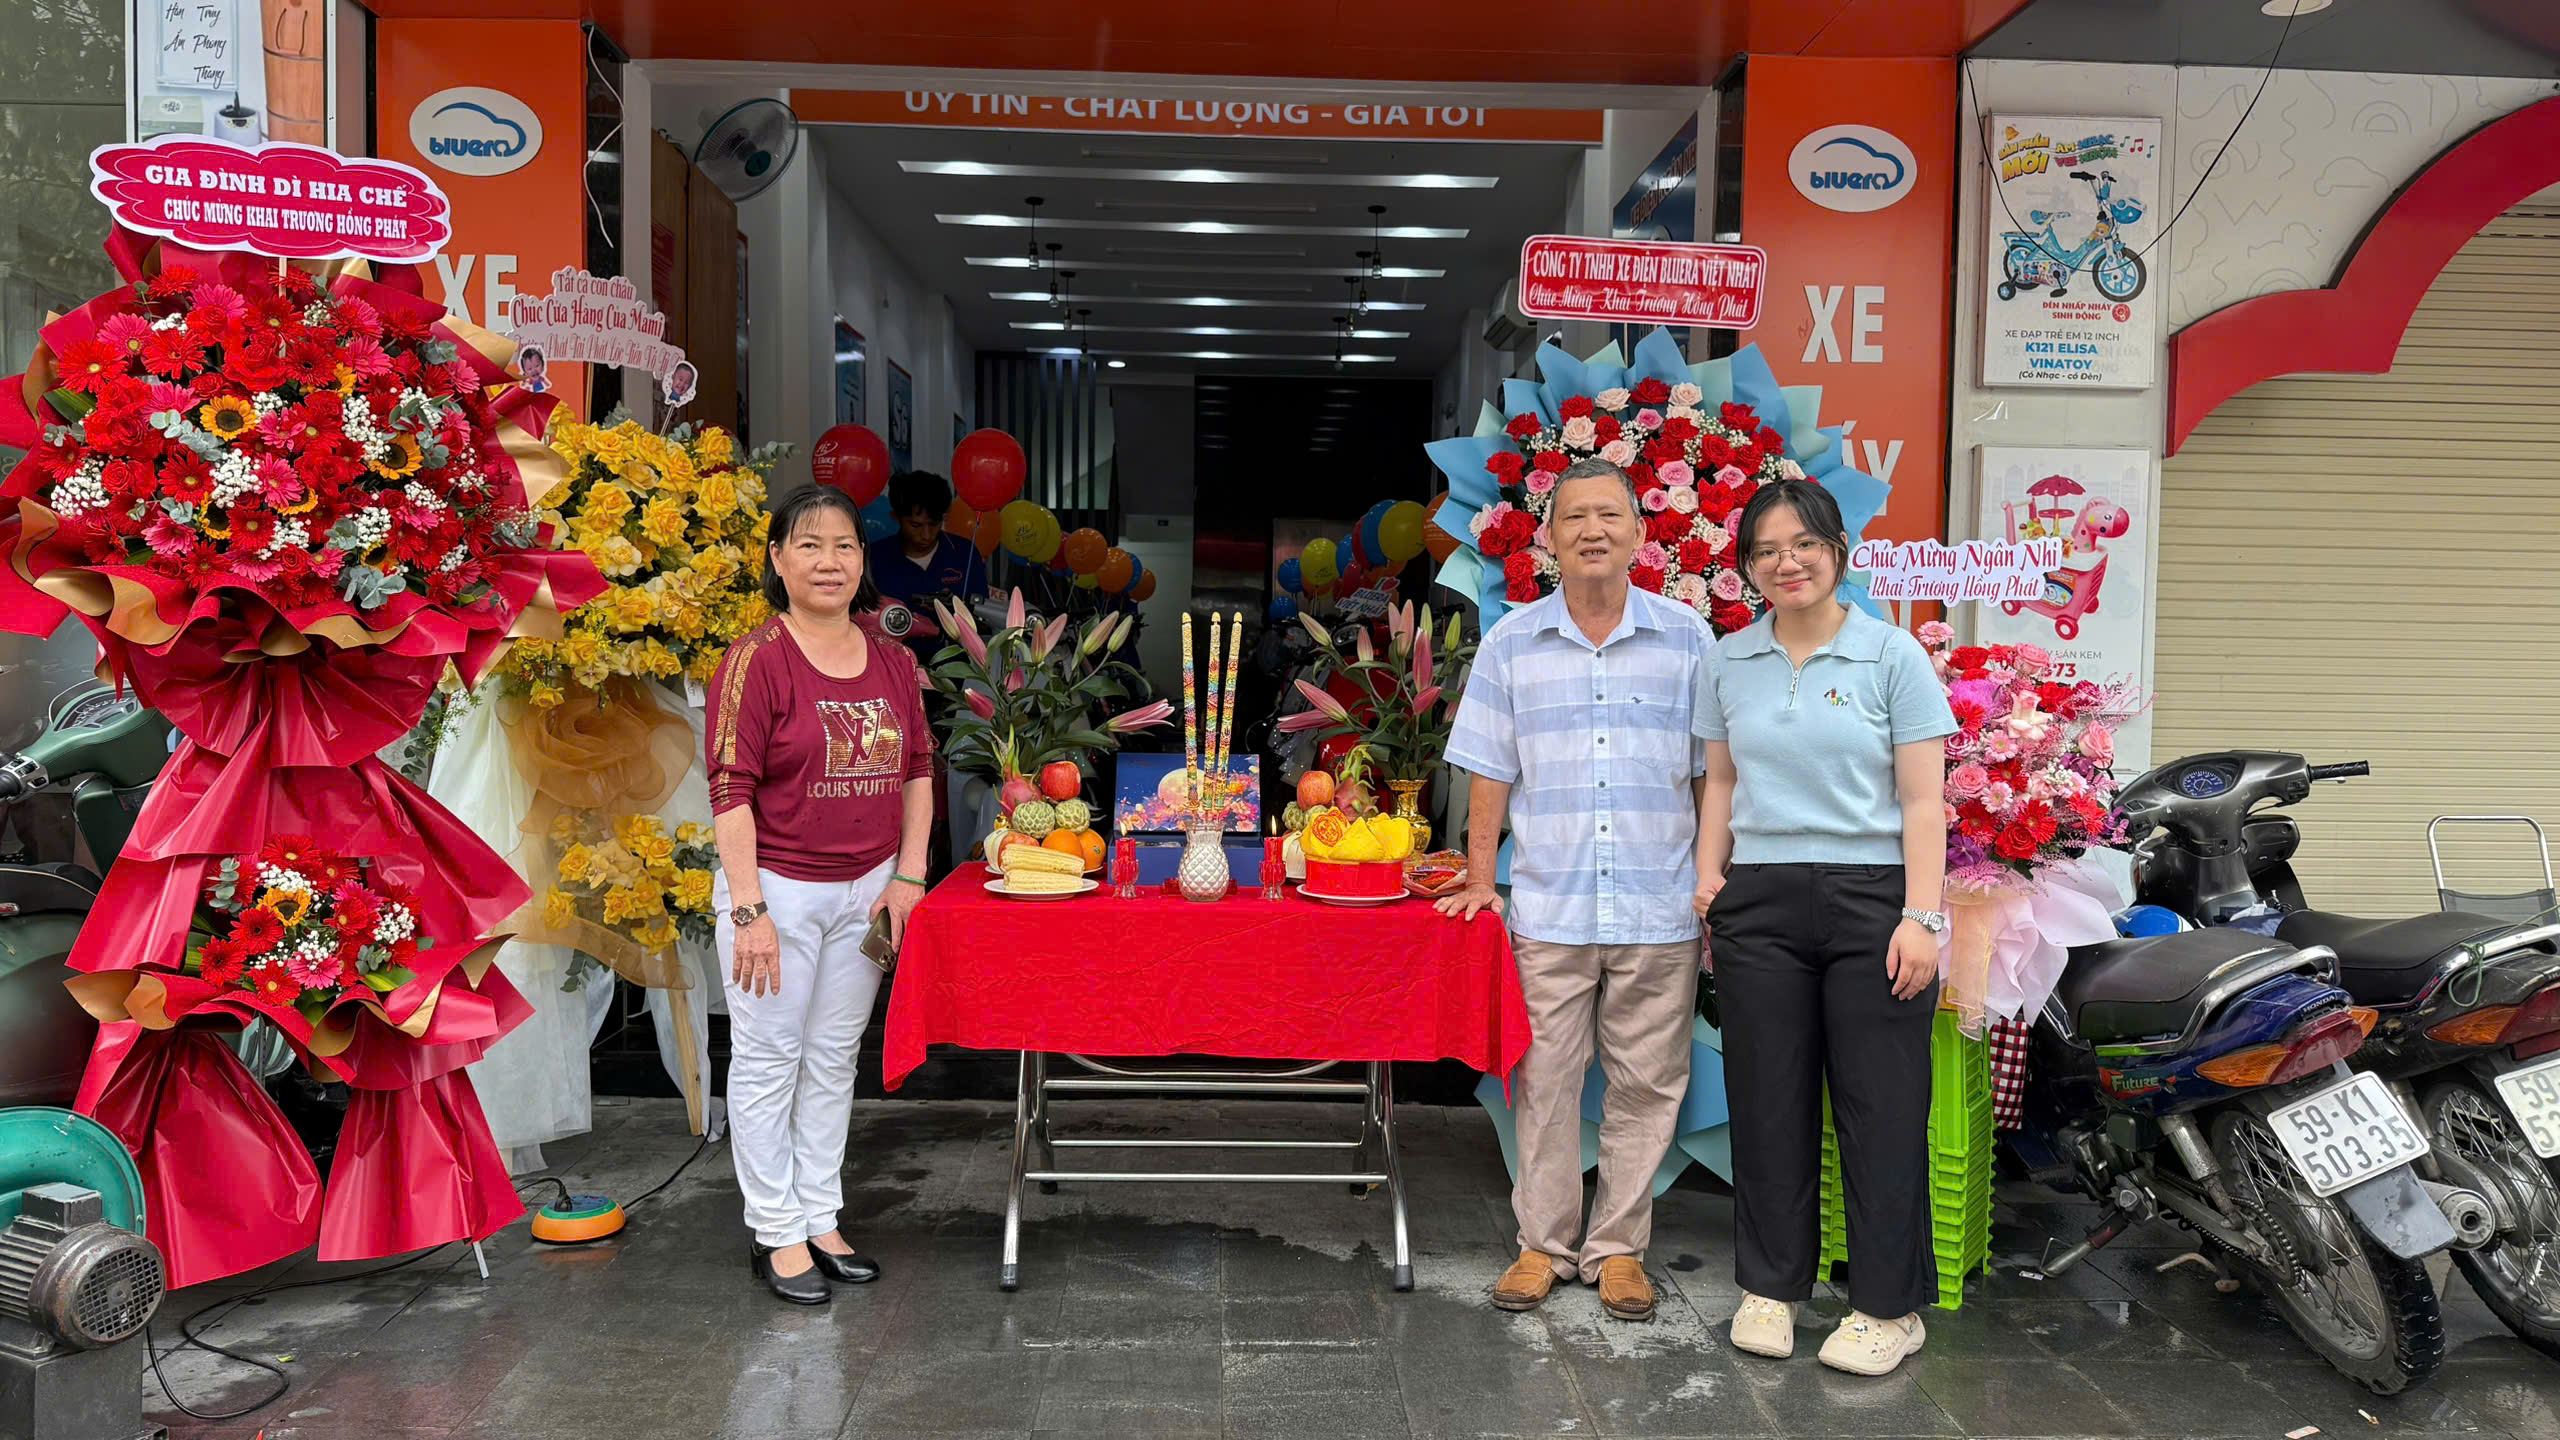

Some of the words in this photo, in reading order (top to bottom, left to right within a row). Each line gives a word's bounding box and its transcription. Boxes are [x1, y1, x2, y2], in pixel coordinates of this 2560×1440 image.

[2002, 150, 2050, 183] MỚI
[145, 164, 192, 187] GIA
[199, 167, 266, 194] ĐÌNH
[273, 175, 302, 197] DÌ
[309, 181, 353, 203] HIA
[359, 184, 408, 208] CHẾ
[163, 195, 201, 222] CHÚC
[203, 197, 243, 226] MỪNG
[246, 206, 279, 229] KHAI
[336, 207, 372, 237] HỒNG
[374, 214, 408, 240] PHÁT
[557, 267, 575, 293] Tất
[591, 279, 608, 296] con
[610, 278, 634, 300] cháu
[1533, 244, 1566, 278] CÔNG
[1569, 251, 1583, 279] TY
[1584, 252, 1616, 281] TNHH
[1616, 254, 1632, 282] XE
[1632, 250, 1658, 288] ĐIỆN
[1659, 255, 1699, 286] BLUERA
[1702, 254, 1726, 293] VIỆT
[1726, 256, 1759, 294] NHẬT
[433, 254, 518, 334] XE
[1529, 282, 1557, 307] Chúc
[1558, 284, 1593, 313] Mừng
[1600, 286, 1631, 311] Khai
[1635, 287, 1678, 318] Trương
[1718, 293, 1749, 321] Phát
[513, 297, 543, 328] Chúc
[570, 295, 604, 333] Hàng
[627, 304, 663, 338] Mami
[1800, 285, 1885, 363] XE
[2052, 312, 2073, 320] SINH
[2005, 329, 2018, 338] XE
[2020, 330, 2042, 341] ĐẠP
[2044, 328, 2063, 340] TRẺ
[2066, 331, 2081, 340] EM
[2083, 332, 2093, 340] 12
[2095, 333, 2120, 341] INCH
[2025, 342, 2054, 353] K121
[2058, 343, 2098, 354] ELISA
[2018, 370, 2034, 380] (Có
[2036, 371, 2059, 381] Nhạc
[2067, 371, 2078, 380] có
[2030, 358, 2093, 370] VINATOY
[1852, 544, 1898, 569] Chúc
[1901, 542, 1957, 575] Mừng
[1962, 542, 2014, 575] Ngân
[2019, 541, 2058, 571] Nhi
[1872, 576, 1904, 597] Khai
[1908, 575, 1959, 603] Trương
[1963, 574, 2001, 603] Hồng
[2005, 575, 2039, 597] Phát
[2080, 650, 2102, 660] KEM
[806, 780, 851, 799] LOUIS
[2303, 995, 2335, 1013] HONDA
[2287, 1084, 2380, 1145] 59-K1
[2302, 1115, 2416, 1187] 503.35
